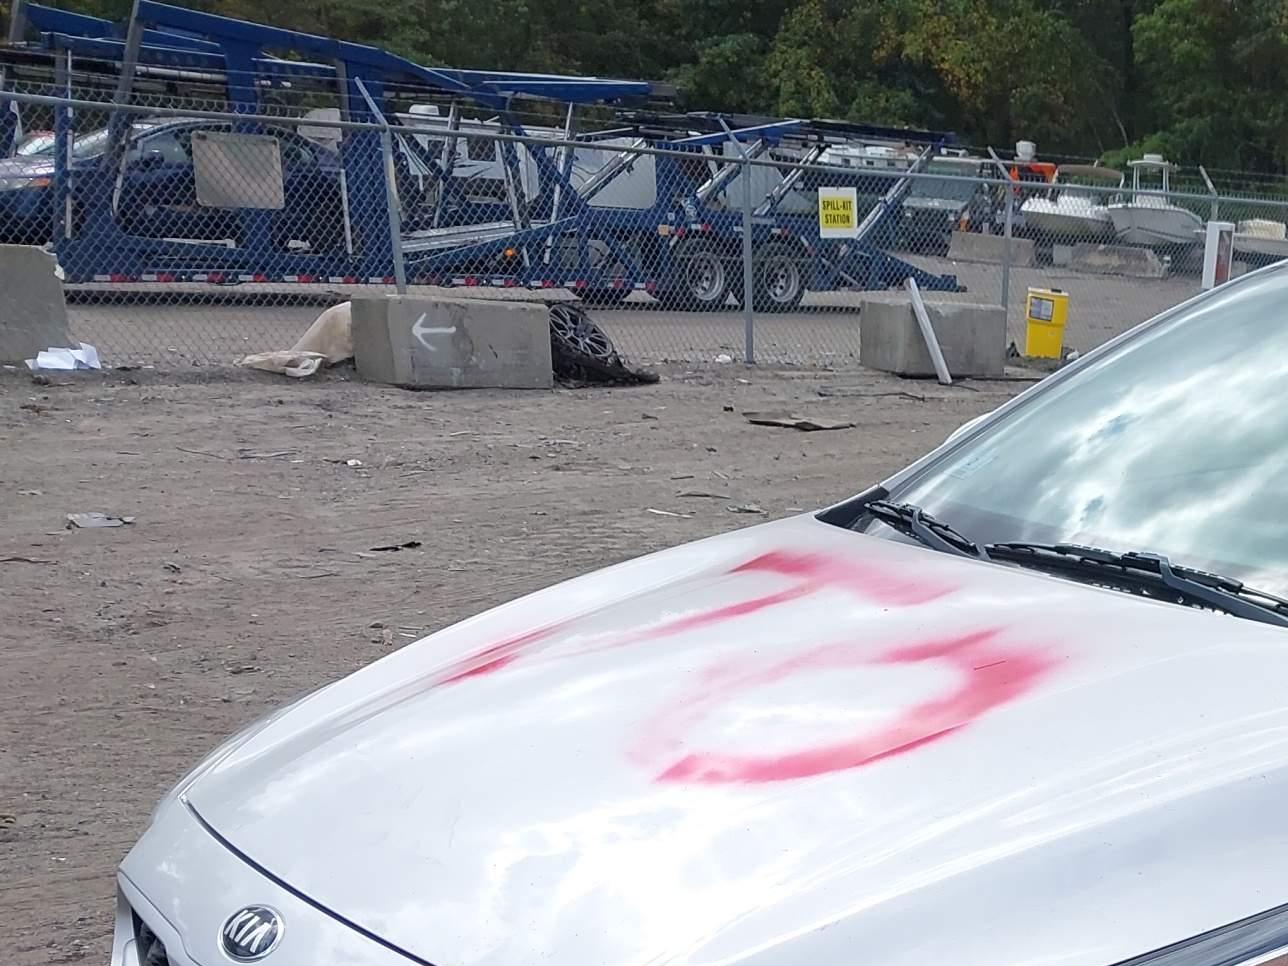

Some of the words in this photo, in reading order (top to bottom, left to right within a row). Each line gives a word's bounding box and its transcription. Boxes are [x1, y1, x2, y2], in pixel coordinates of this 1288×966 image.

[822, 200, 852, 210] SPILL-KIT
[825, 213, 850, 224] STATION
[223, 909, 272, 954] KIA
